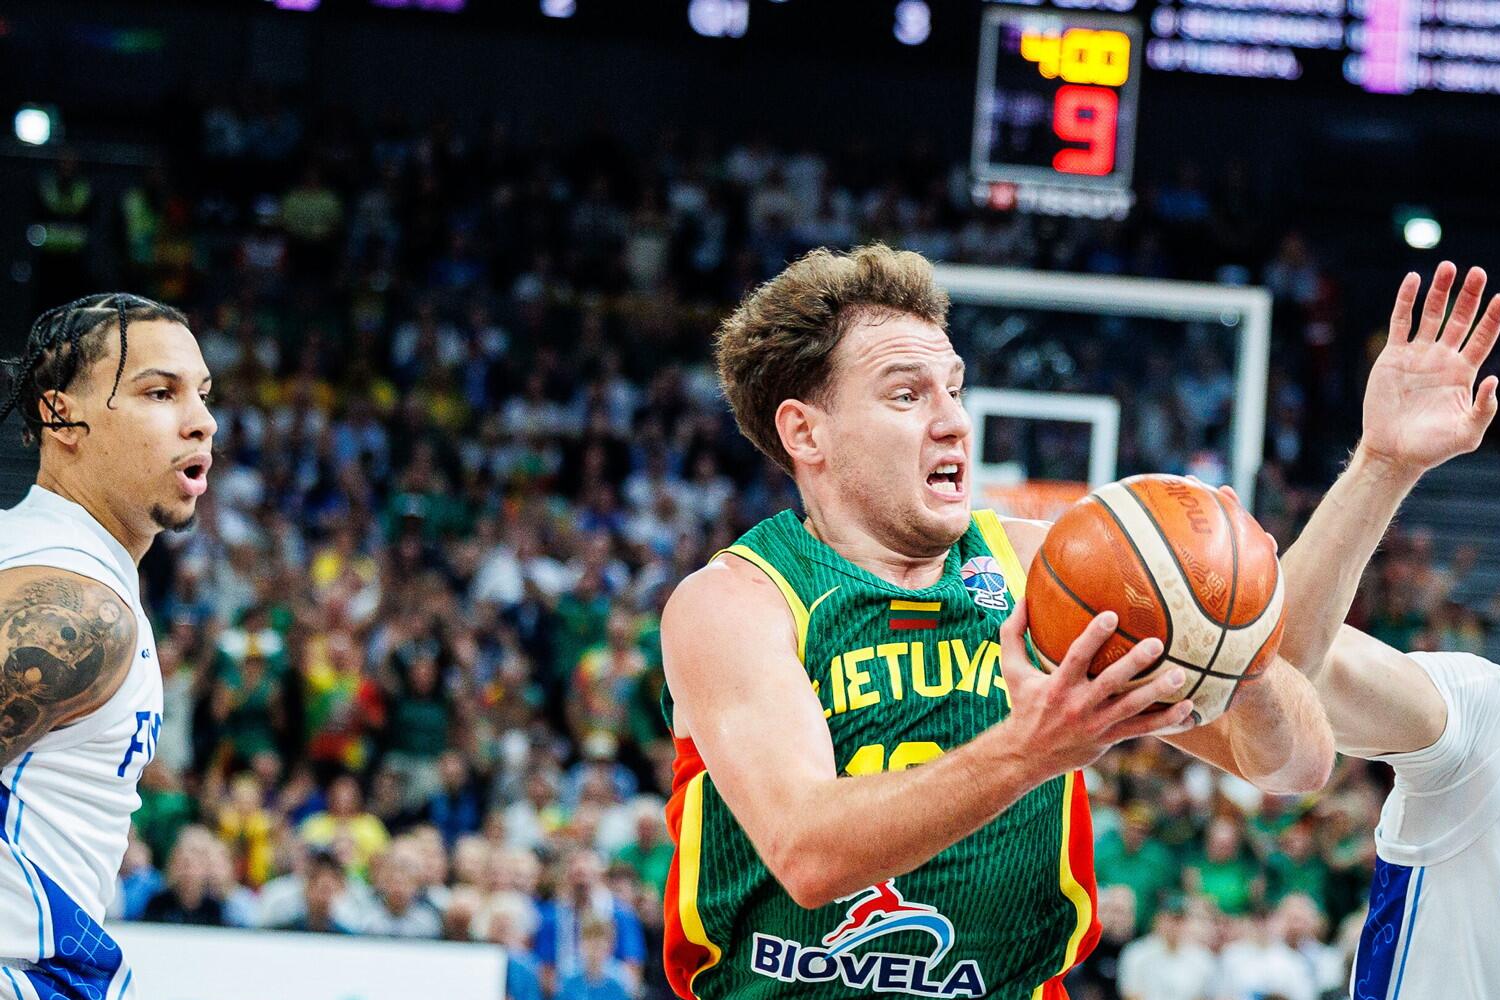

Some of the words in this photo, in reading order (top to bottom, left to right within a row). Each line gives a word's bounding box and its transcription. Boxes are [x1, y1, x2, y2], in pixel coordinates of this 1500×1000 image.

[1053, 85, 1119, 176] 9
[811, 639, 1012, 720] IETUVA
[755, 936, 983, 997] BIOVELA
